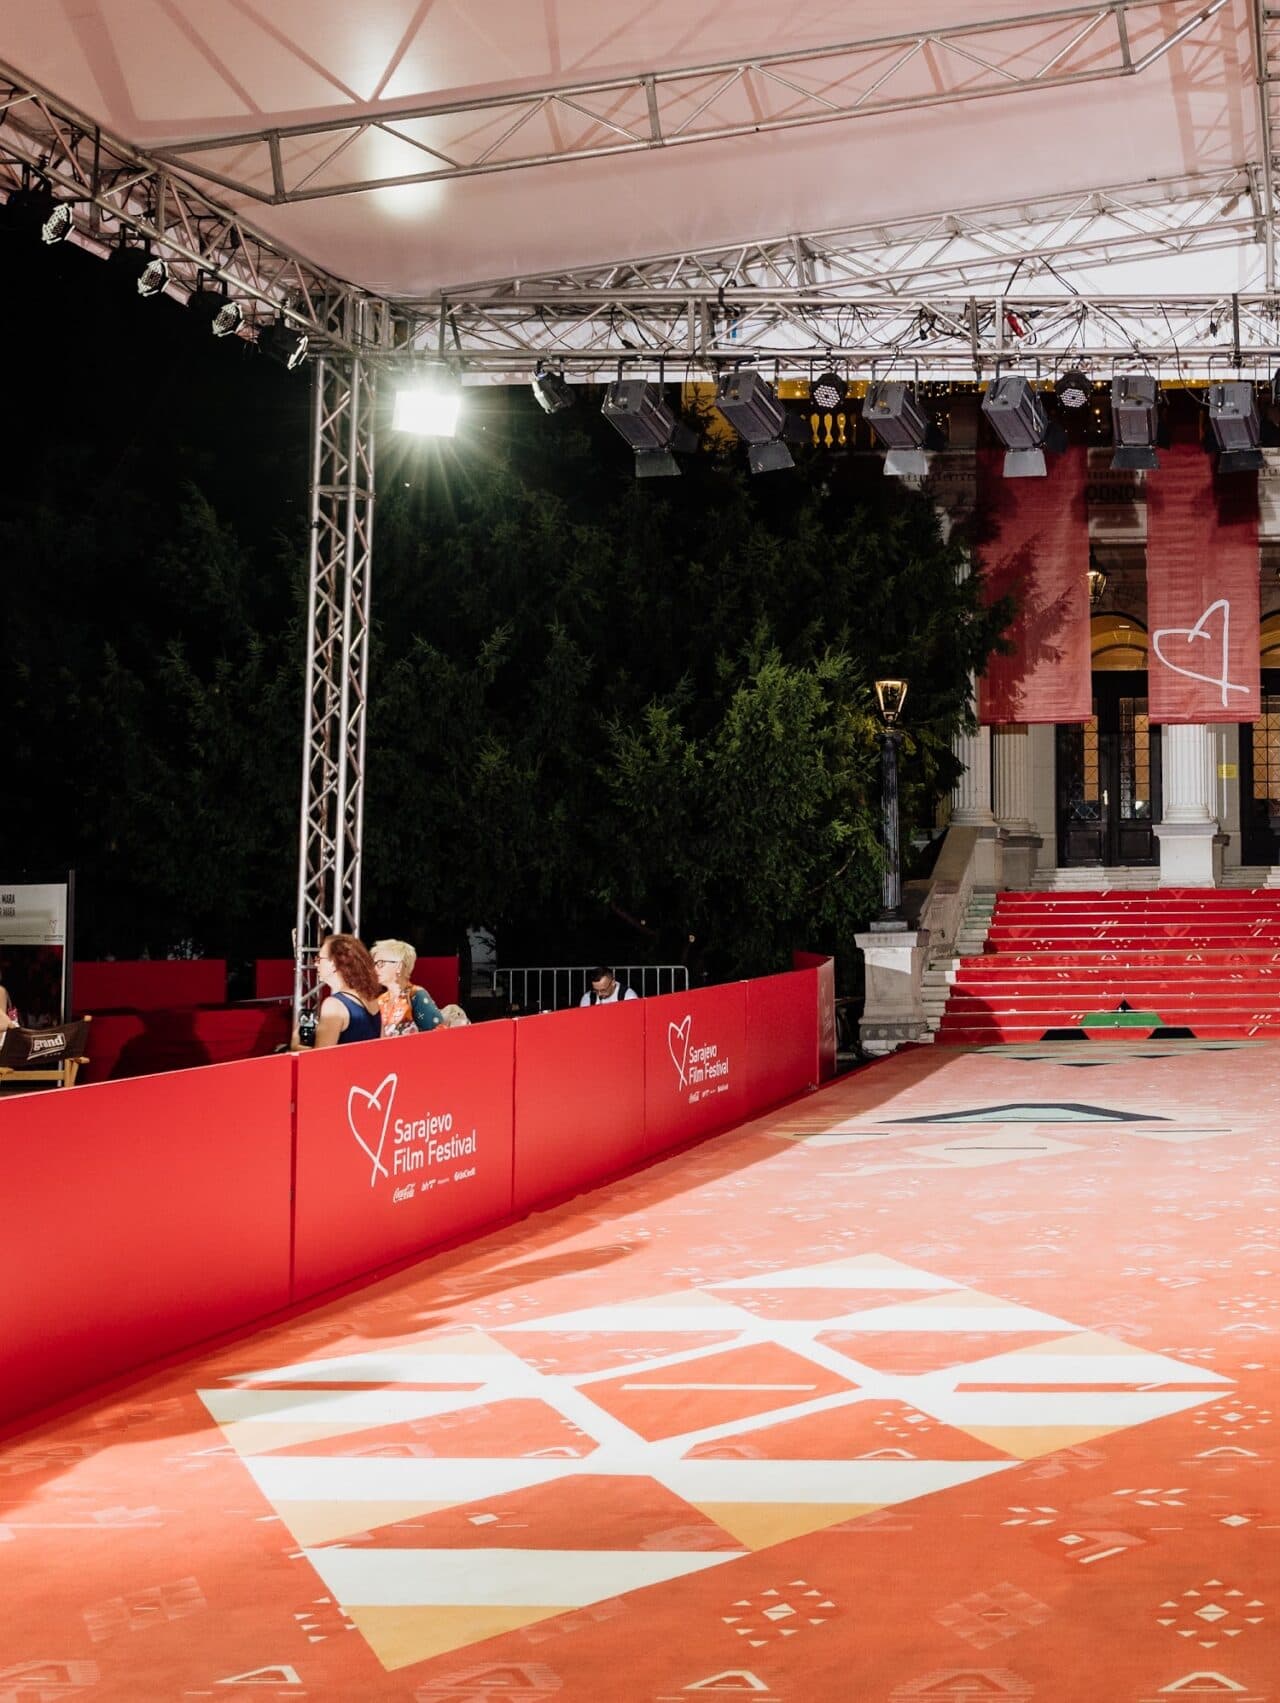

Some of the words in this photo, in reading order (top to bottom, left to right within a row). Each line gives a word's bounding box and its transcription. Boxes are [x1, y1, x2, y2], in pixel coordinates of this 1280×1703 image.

[688, 1042, 717, 1065] Sarajevo
[688, 1066, 704, 1085] Film
[704, 1056, 729, 1080] Festival
[393, 1112, 453, 1145] Sarajevo
[393, 1146, 424, 1176] Film
[427, 1129, 477, 1166] Festival
